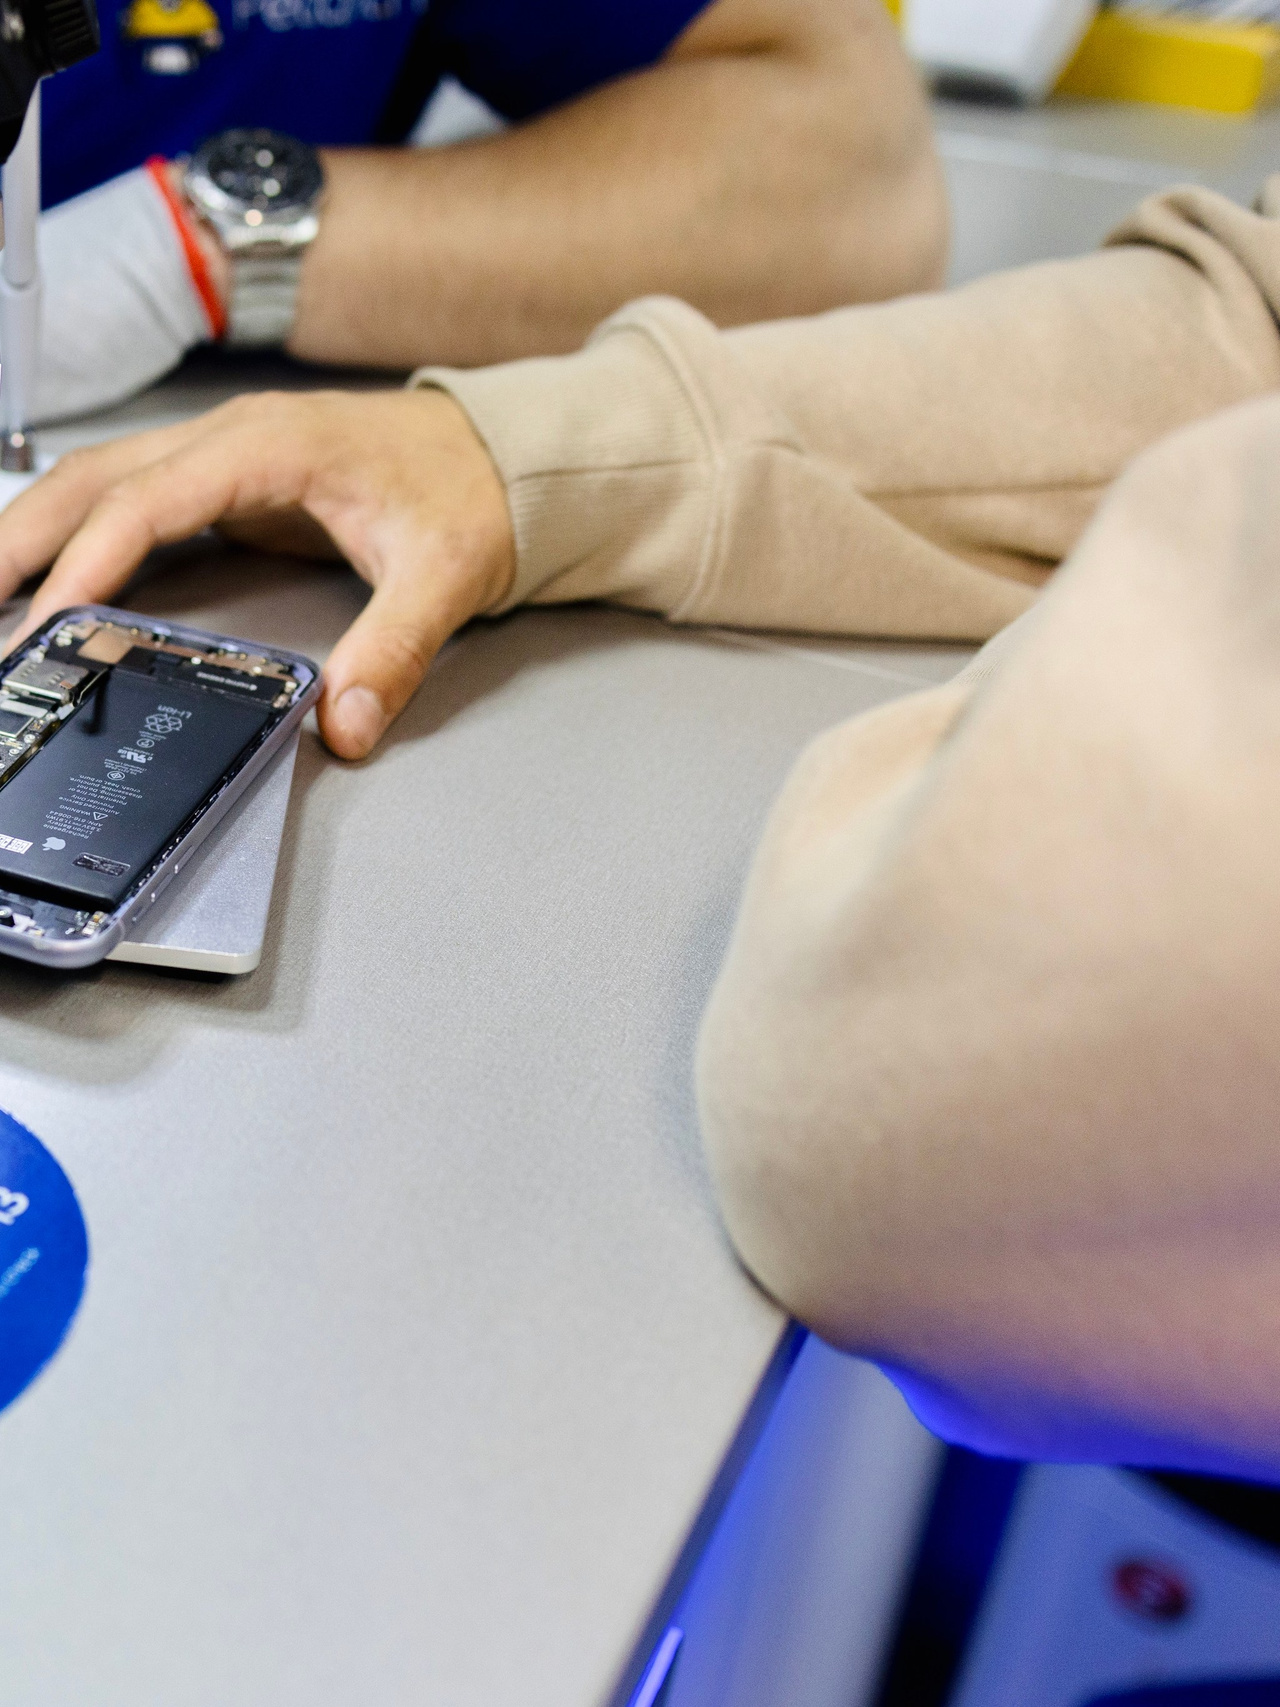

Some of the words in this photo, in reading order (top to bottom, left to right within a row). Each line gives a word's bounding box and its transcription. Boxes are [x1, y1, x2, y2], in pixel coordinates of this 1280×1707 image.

[157, 704, 192, 719] Li-ion
[69, 777, 100, 787] puncture,
[101, 785, 142, 798] disassemble,
[121, 785, 140, 793] crush,
[100, 790, 126, 800] burning.
[59, 797, 83, 805] Service
[87, 799, 114, 809] Provider
[98, 795, 127, 806] Potential
[59, 805, 90, 816] WARNING
[84, 803, 120, 815] Authorized
[47, 820, 72, 830] Battery
[72, 826, 92, 834] Li-ion
[43, 824, 89, 839] Rechargeable
